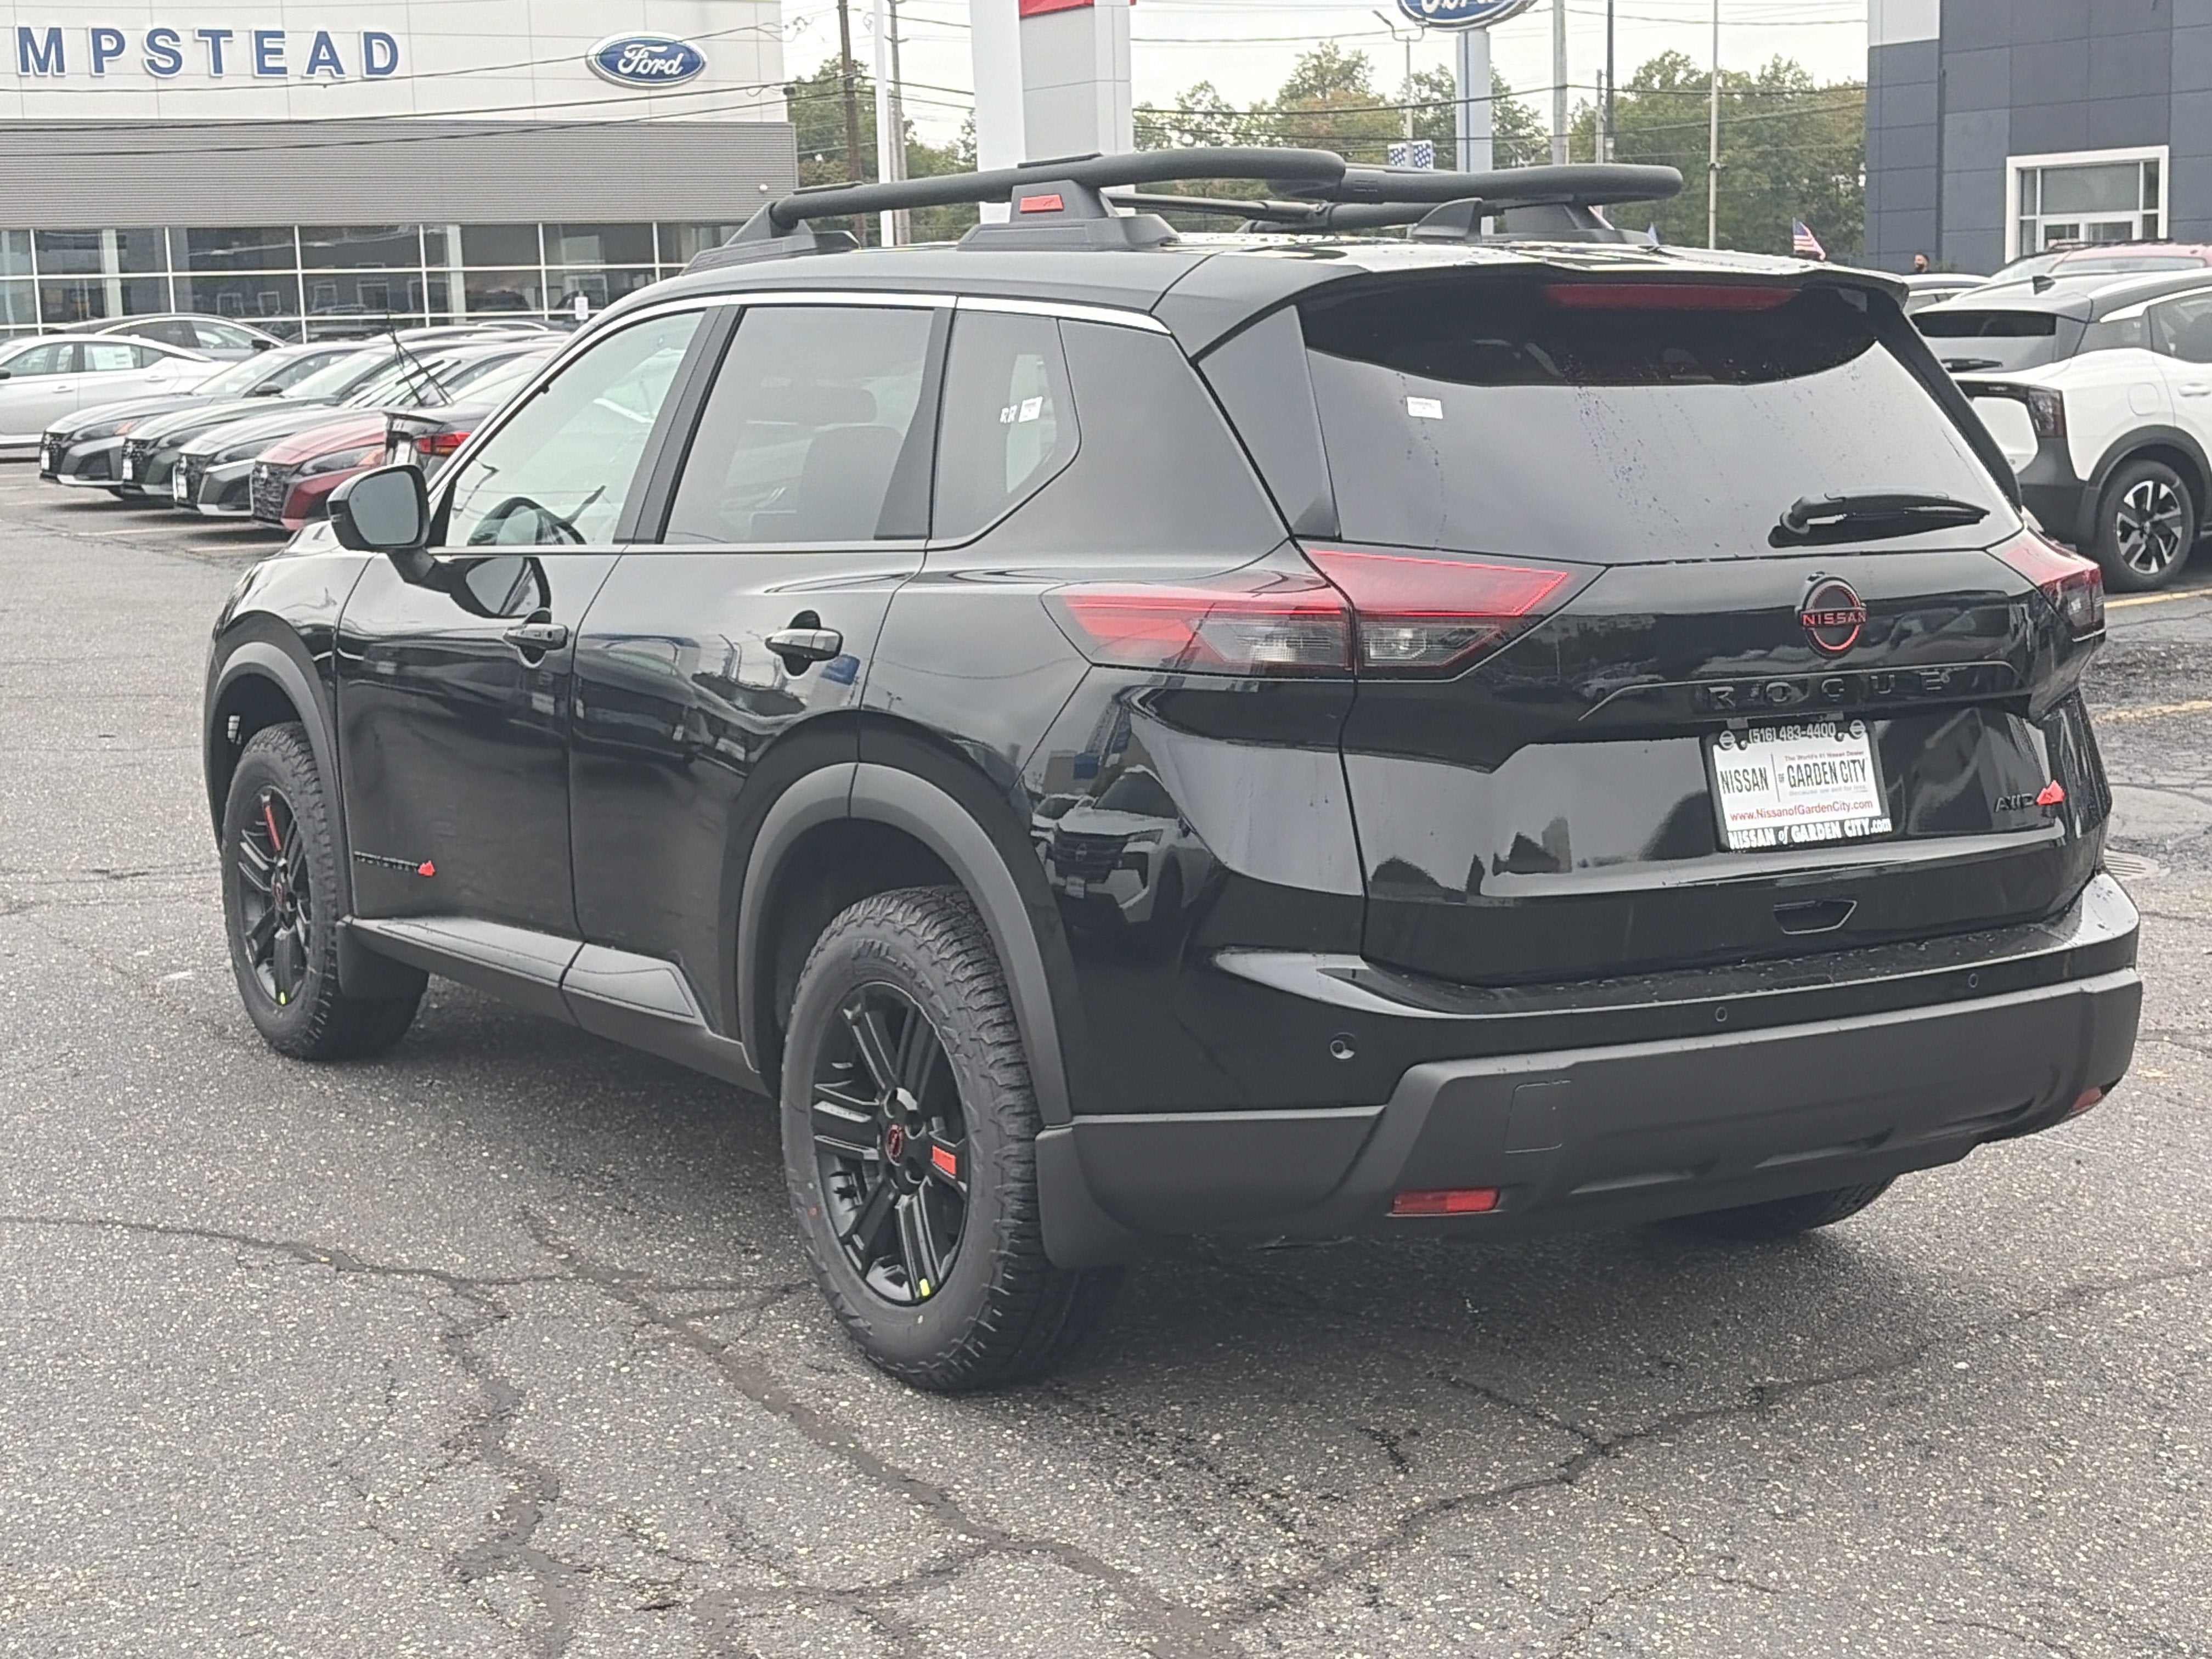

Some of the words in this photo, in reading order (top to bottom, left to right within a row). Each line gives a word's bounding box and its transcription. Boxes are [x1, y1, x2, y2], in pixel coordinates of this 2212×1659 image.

[15, 26, 399, 77] MPSTEAD
[617, 44, 684, 74] Ford
[1803, 612, 1866, 626] NISSAN
[1707, 670, 1945, 709] ROGUE
[1748, 727, 1776, 743] (516)
[1779, 723, 1836, 740] 483-4400
[1719, 767, 1769, 794] NISSAN
[1787, 761, 1838, 788] GARDEN
[1839, 758, 1865, 783] CITY
[1729, 799, 1874, 822] www.NissanofGardenCity.com
[1728, 828, 1776, 850] NISSAN
[1778, 826, 1788, 844] of
[1791, 820, 1842, 843] GARDEN
